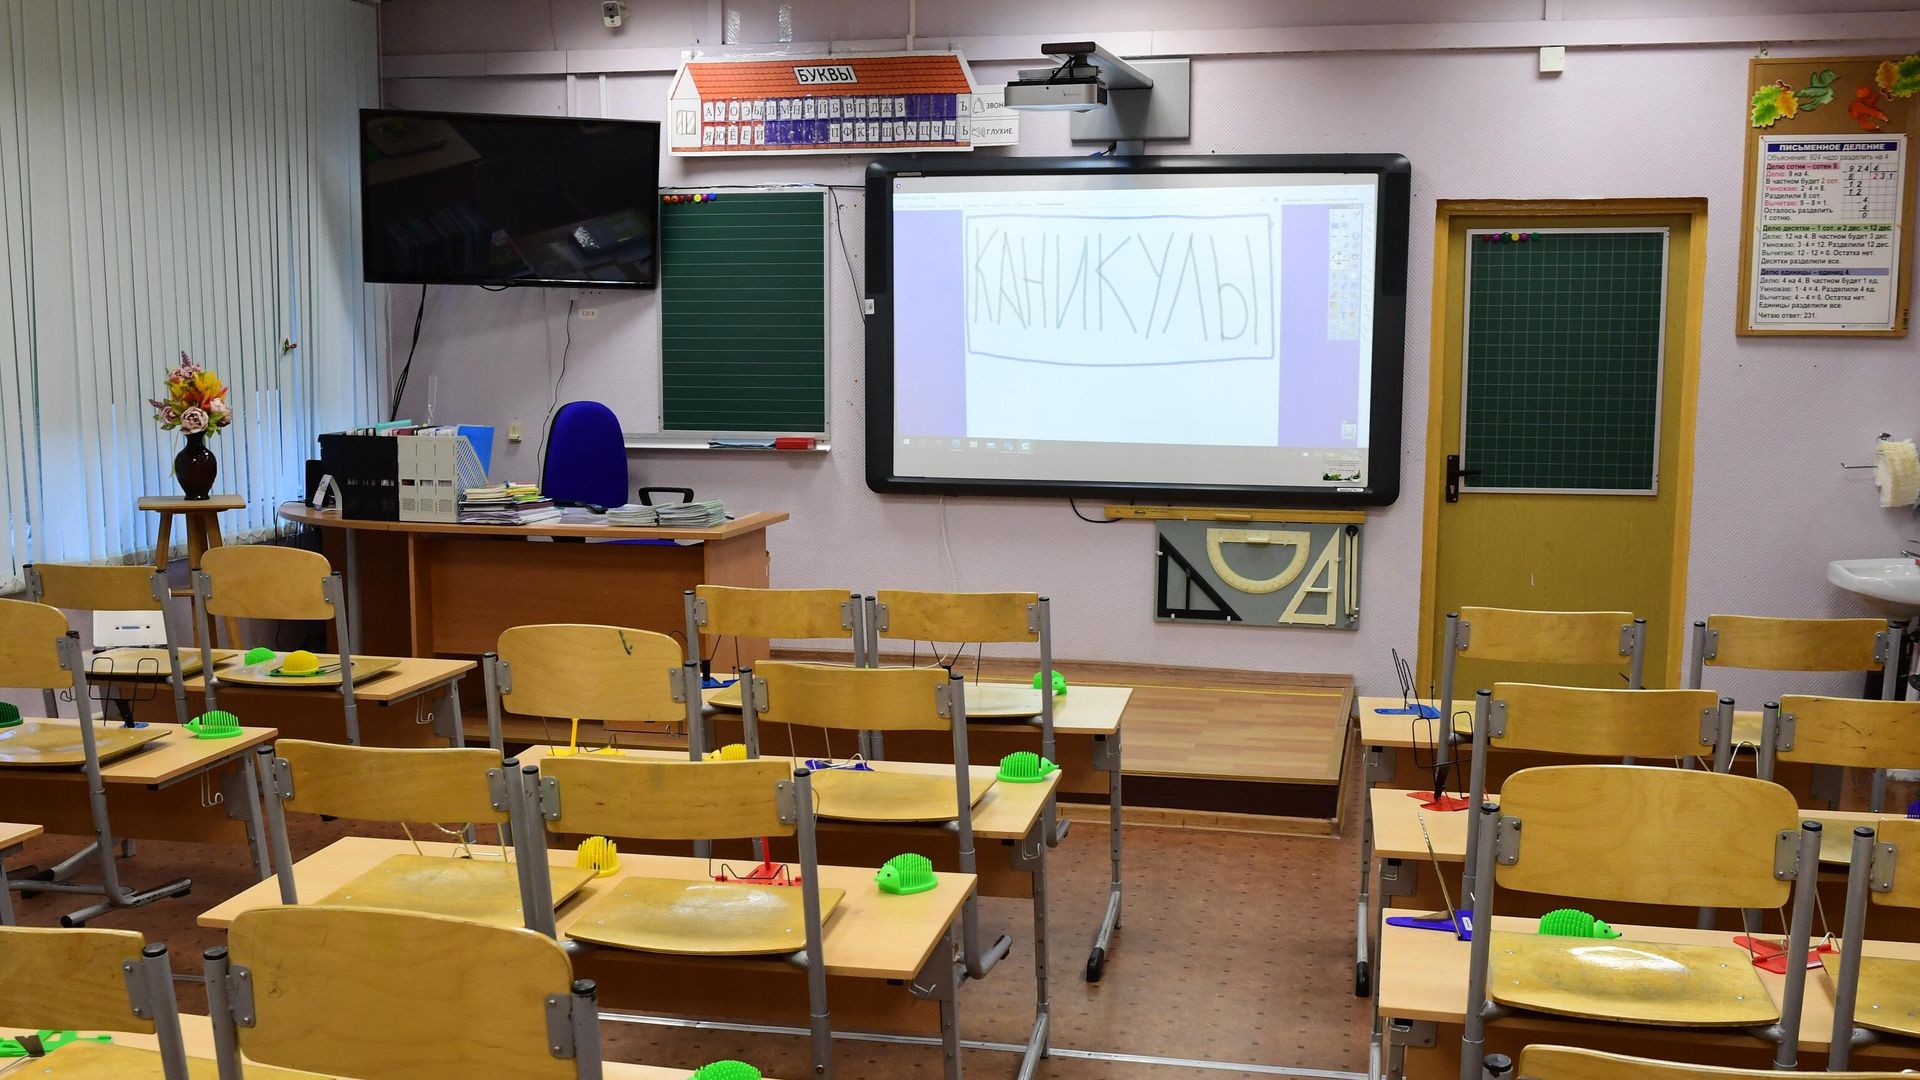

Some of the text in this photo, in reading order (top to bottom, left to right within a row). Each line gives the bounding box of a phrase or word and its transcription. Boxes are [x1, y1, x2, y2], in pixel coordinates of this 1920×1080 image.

[797, 67, 853, 82] БУКВЫ
[705, 101, 968, 116] А У О Э Ы Л М Н Р Й Б В Г Д Ж З Ъ
[705, 125, 968, 140] Я Ю Ё Е И П Ф К Т Ш С Х Ц Ч Щ Ь
[974, 228, 1258, 346] КАНИКУЛЫ
